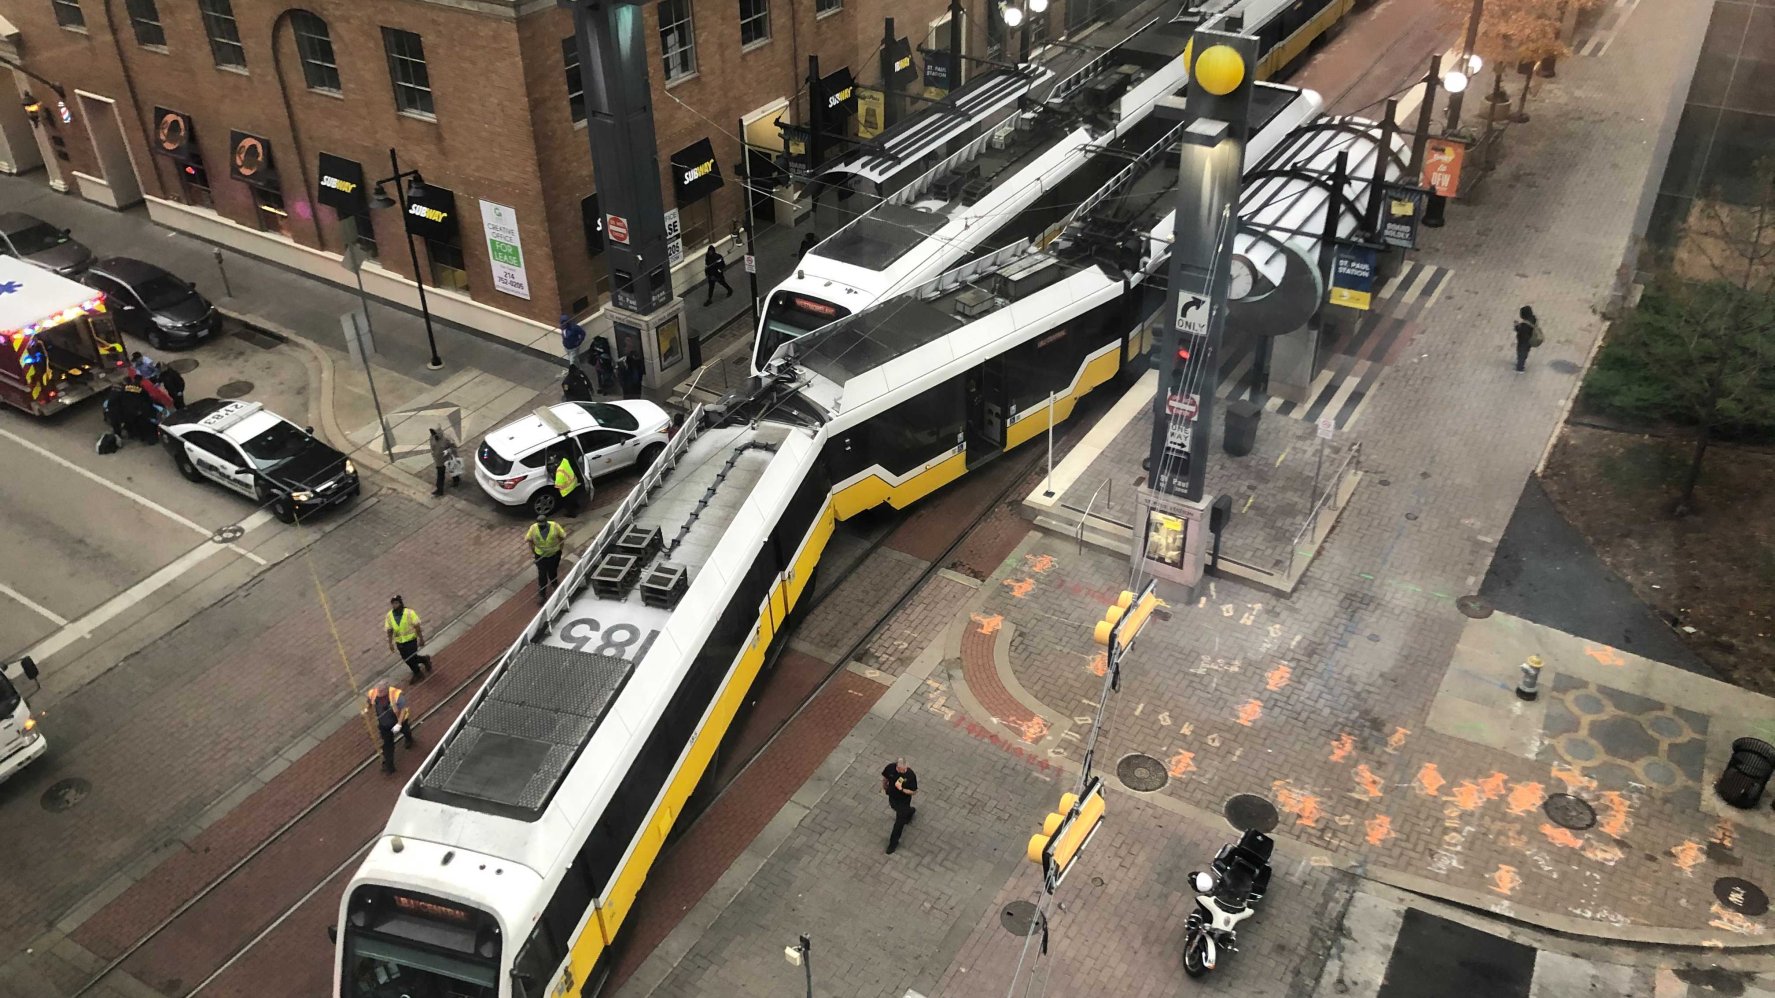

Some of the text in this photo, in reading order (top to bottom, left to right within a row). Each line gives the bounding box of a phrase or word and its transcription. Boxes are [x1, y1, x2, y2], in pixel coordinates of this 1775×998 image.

[828, 86, 853, 109] SUBWAY
[683, 158, 715, 185] SUBWAY
[320, 175, 357, 194] SUBWAY
[408, 203, 448, 223] SUBWAY
[491, 232, 513, 242] OFFICE
[496, 242, 512, 254] FOR
[494, 252, 518, 266] LEASE
[1350, 261, 1370, 270] PAUL
[1338, 266, 1370, 278] STATION
[1177, 318, 1205, 332] ONLY
